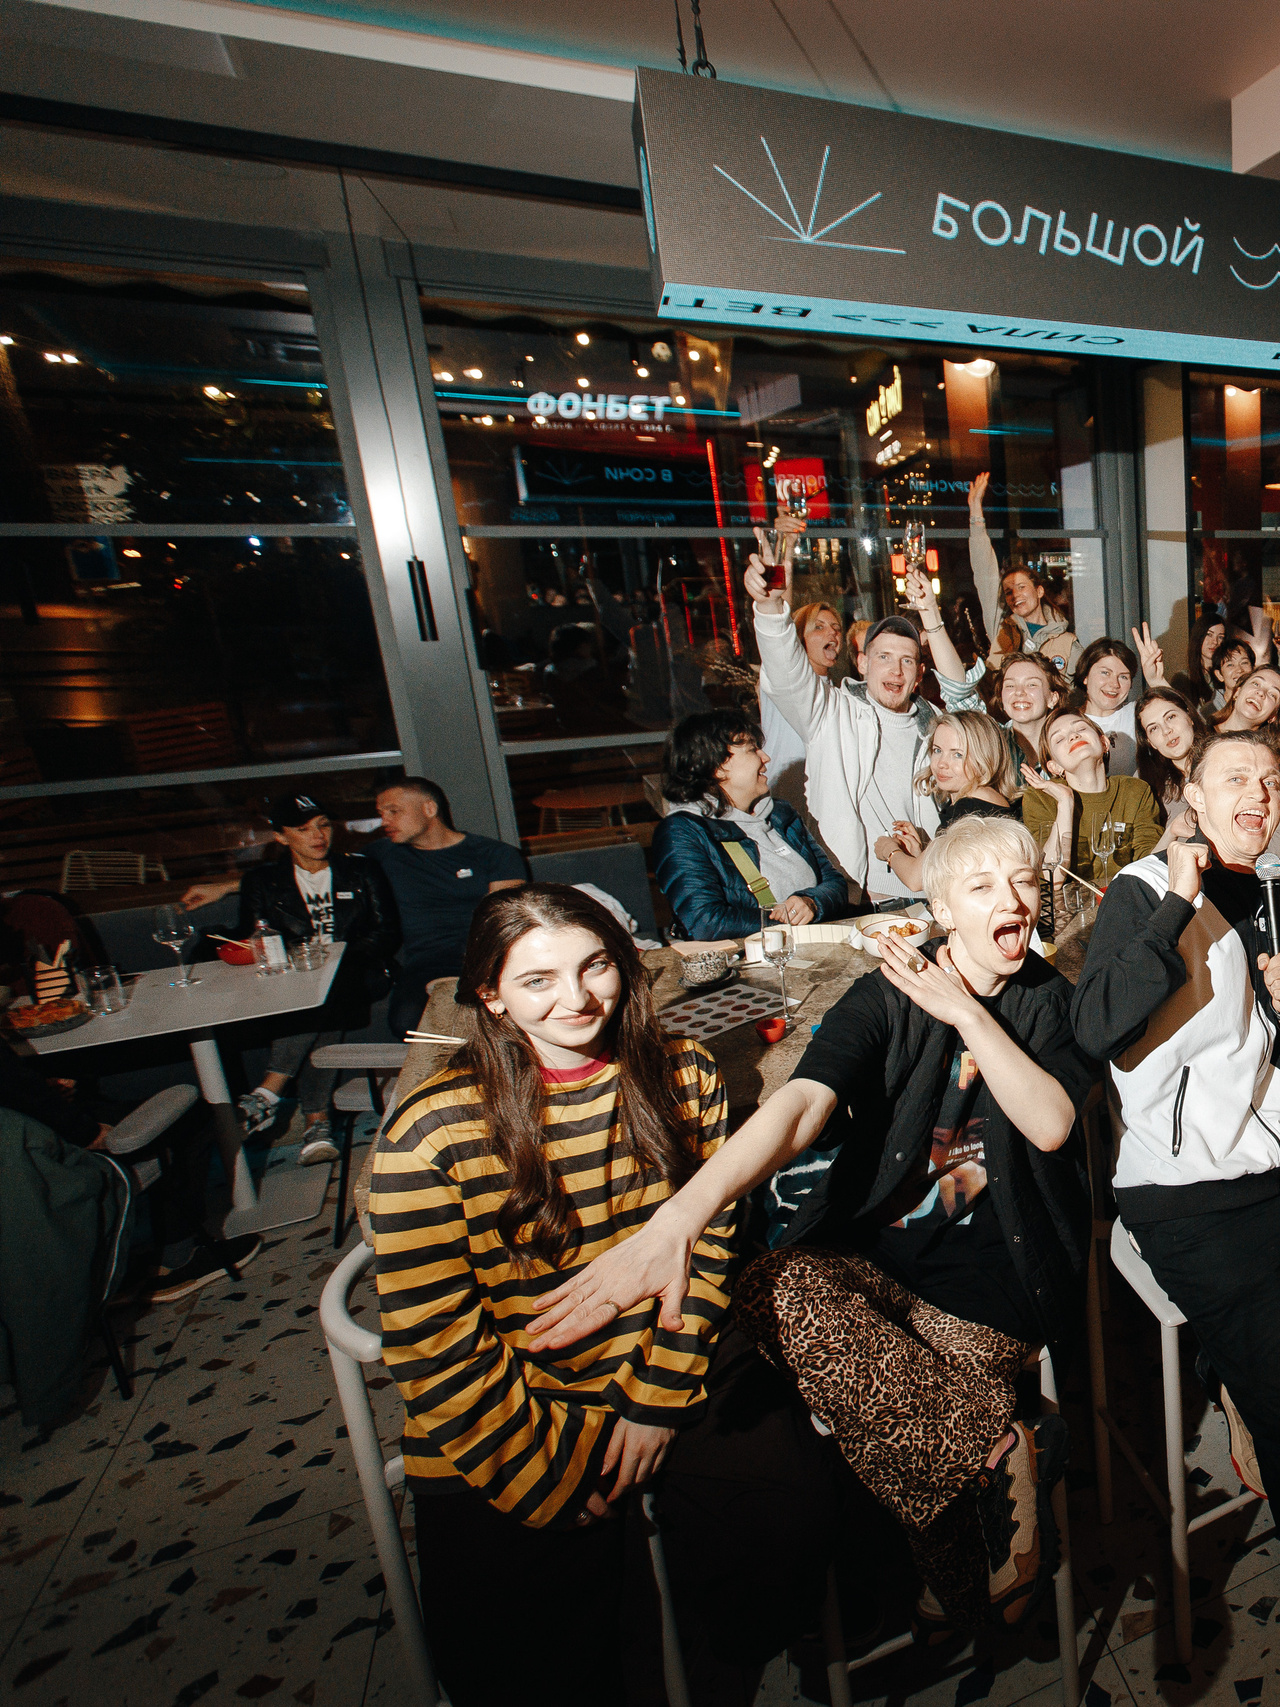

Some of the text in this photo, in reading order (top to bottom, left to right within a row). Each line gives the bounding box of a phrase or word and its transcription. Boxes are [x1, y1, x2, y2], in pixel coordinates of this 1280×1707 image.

[931, 192, 1205, 274] БОЛЬШОЙ
[966, 323, 1127, 346] СИЛА
[526, 391, 673, 422] ФОНБЕТ
